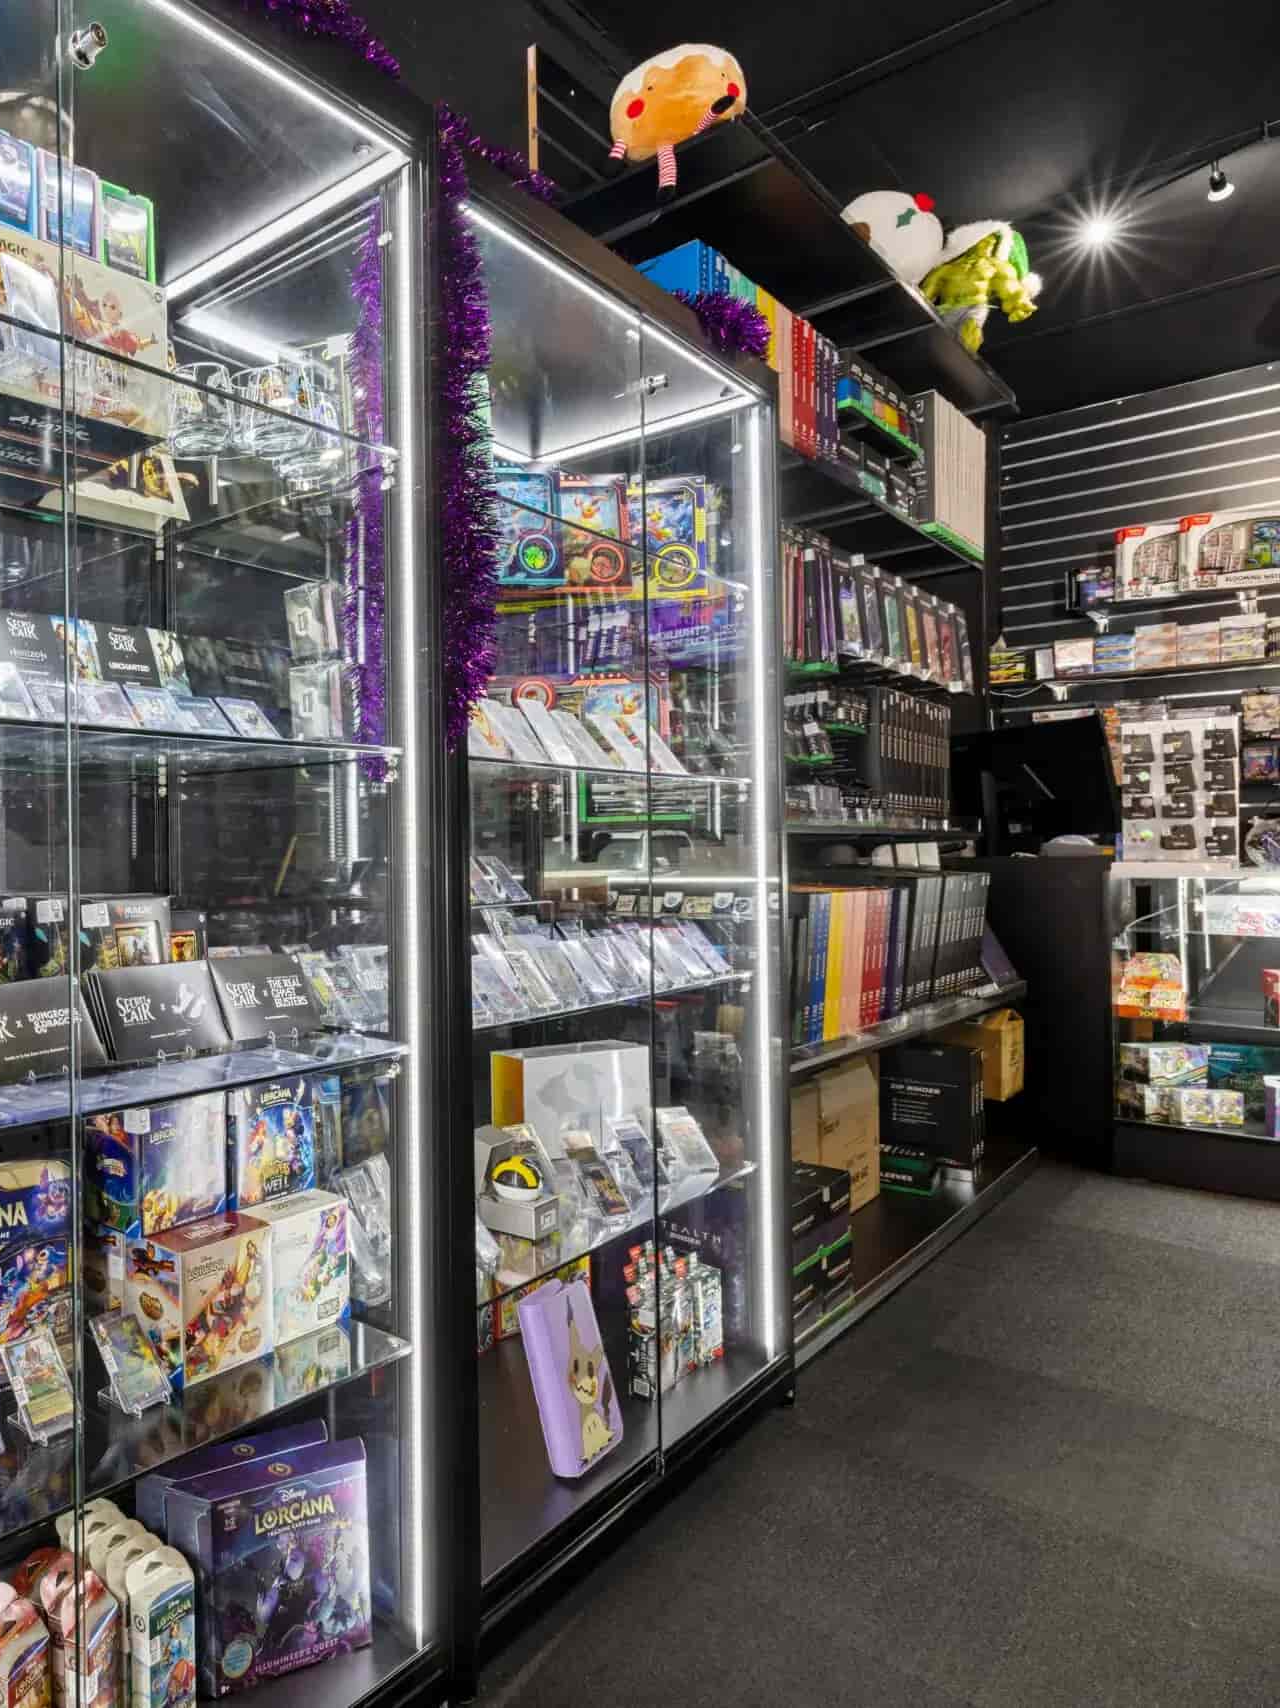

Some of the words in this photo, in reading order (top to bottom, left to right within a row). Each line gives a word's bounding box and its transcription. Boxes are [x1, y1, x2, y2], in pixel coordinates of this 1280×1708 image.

[116, 995, 152, 1017] SECRET
[123, 1002, 156, 1025] LAIR
[260, 1087, 292, 1104] LORCANA
[254, 1494, 336, 1536] LORCANA
